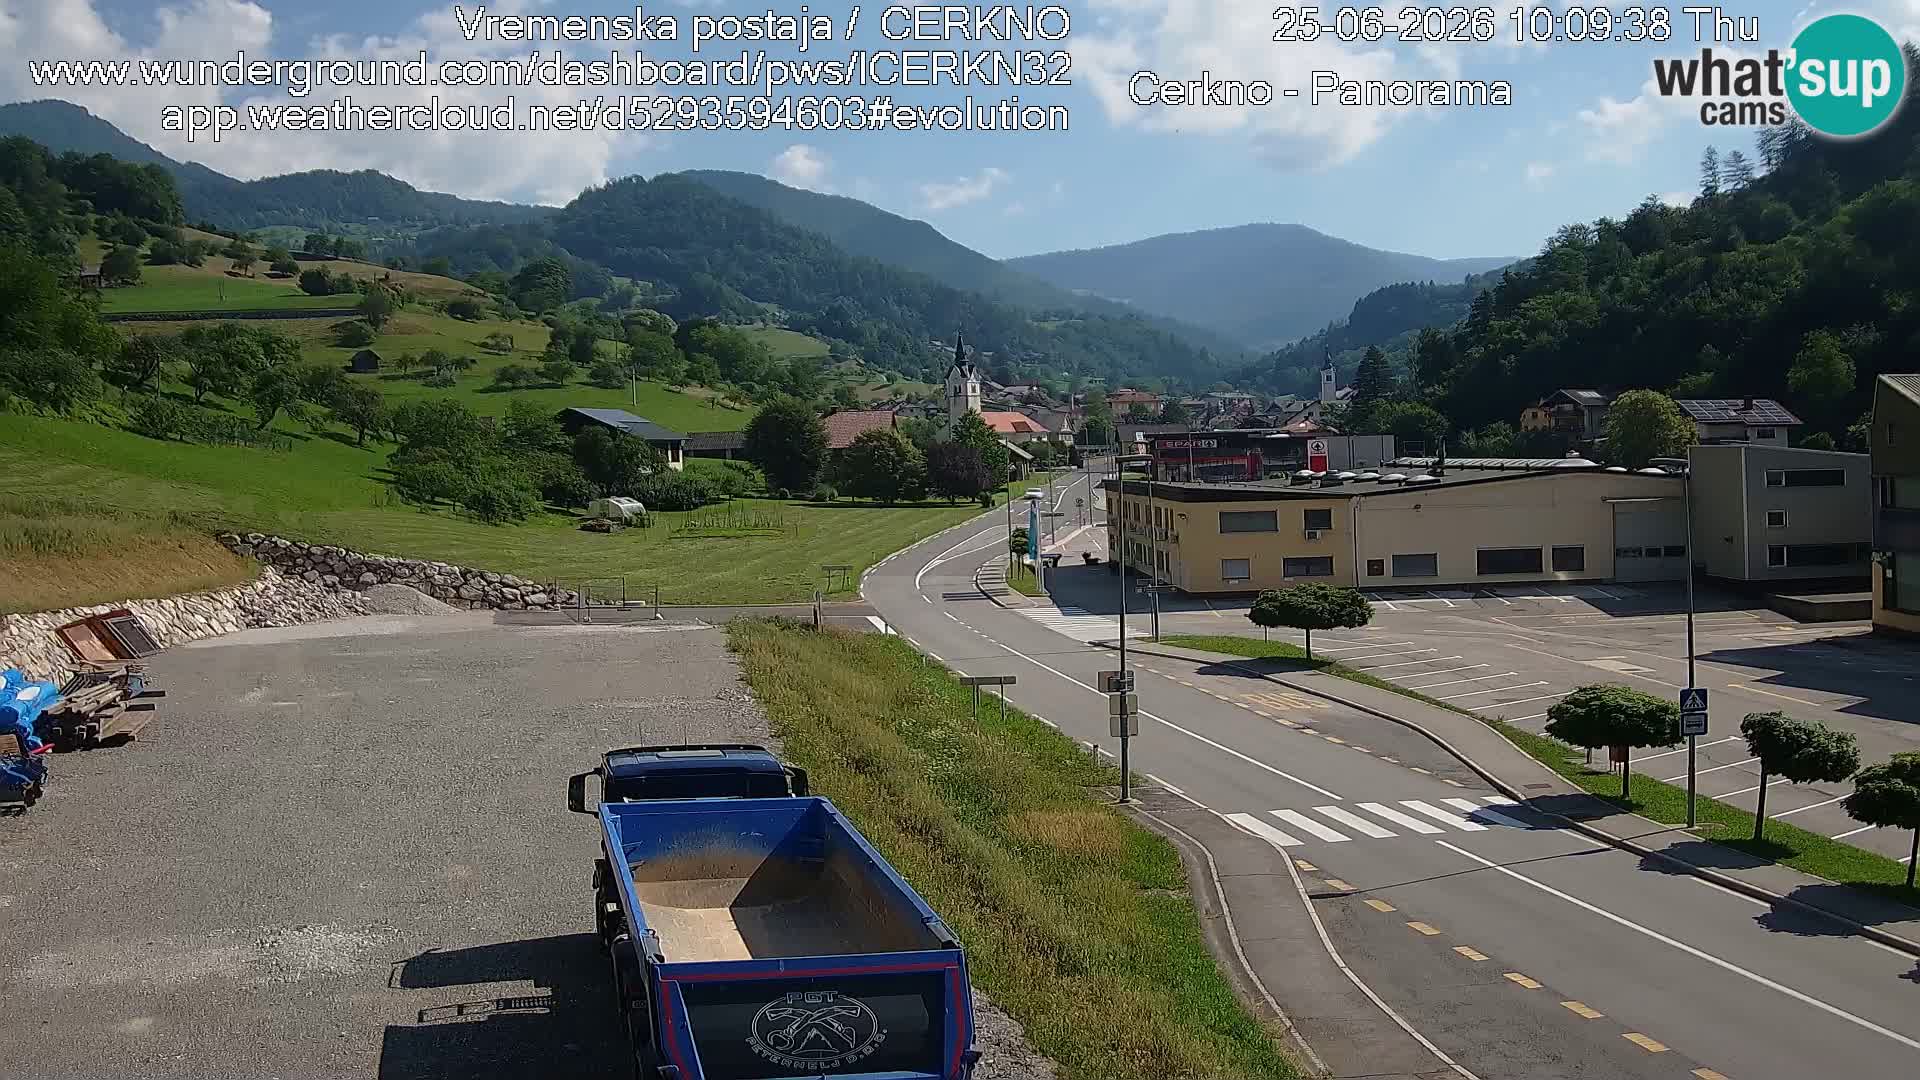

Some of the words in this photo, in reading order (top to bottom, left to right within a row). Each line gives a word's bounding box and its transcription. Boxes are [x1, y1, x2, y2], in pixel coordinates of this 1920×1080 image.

[1166, 440, 1201, 448] SPAR
[786, 991, 838, 1004] PGT
[745, 1036, 841, 1070] PETERNELJ
